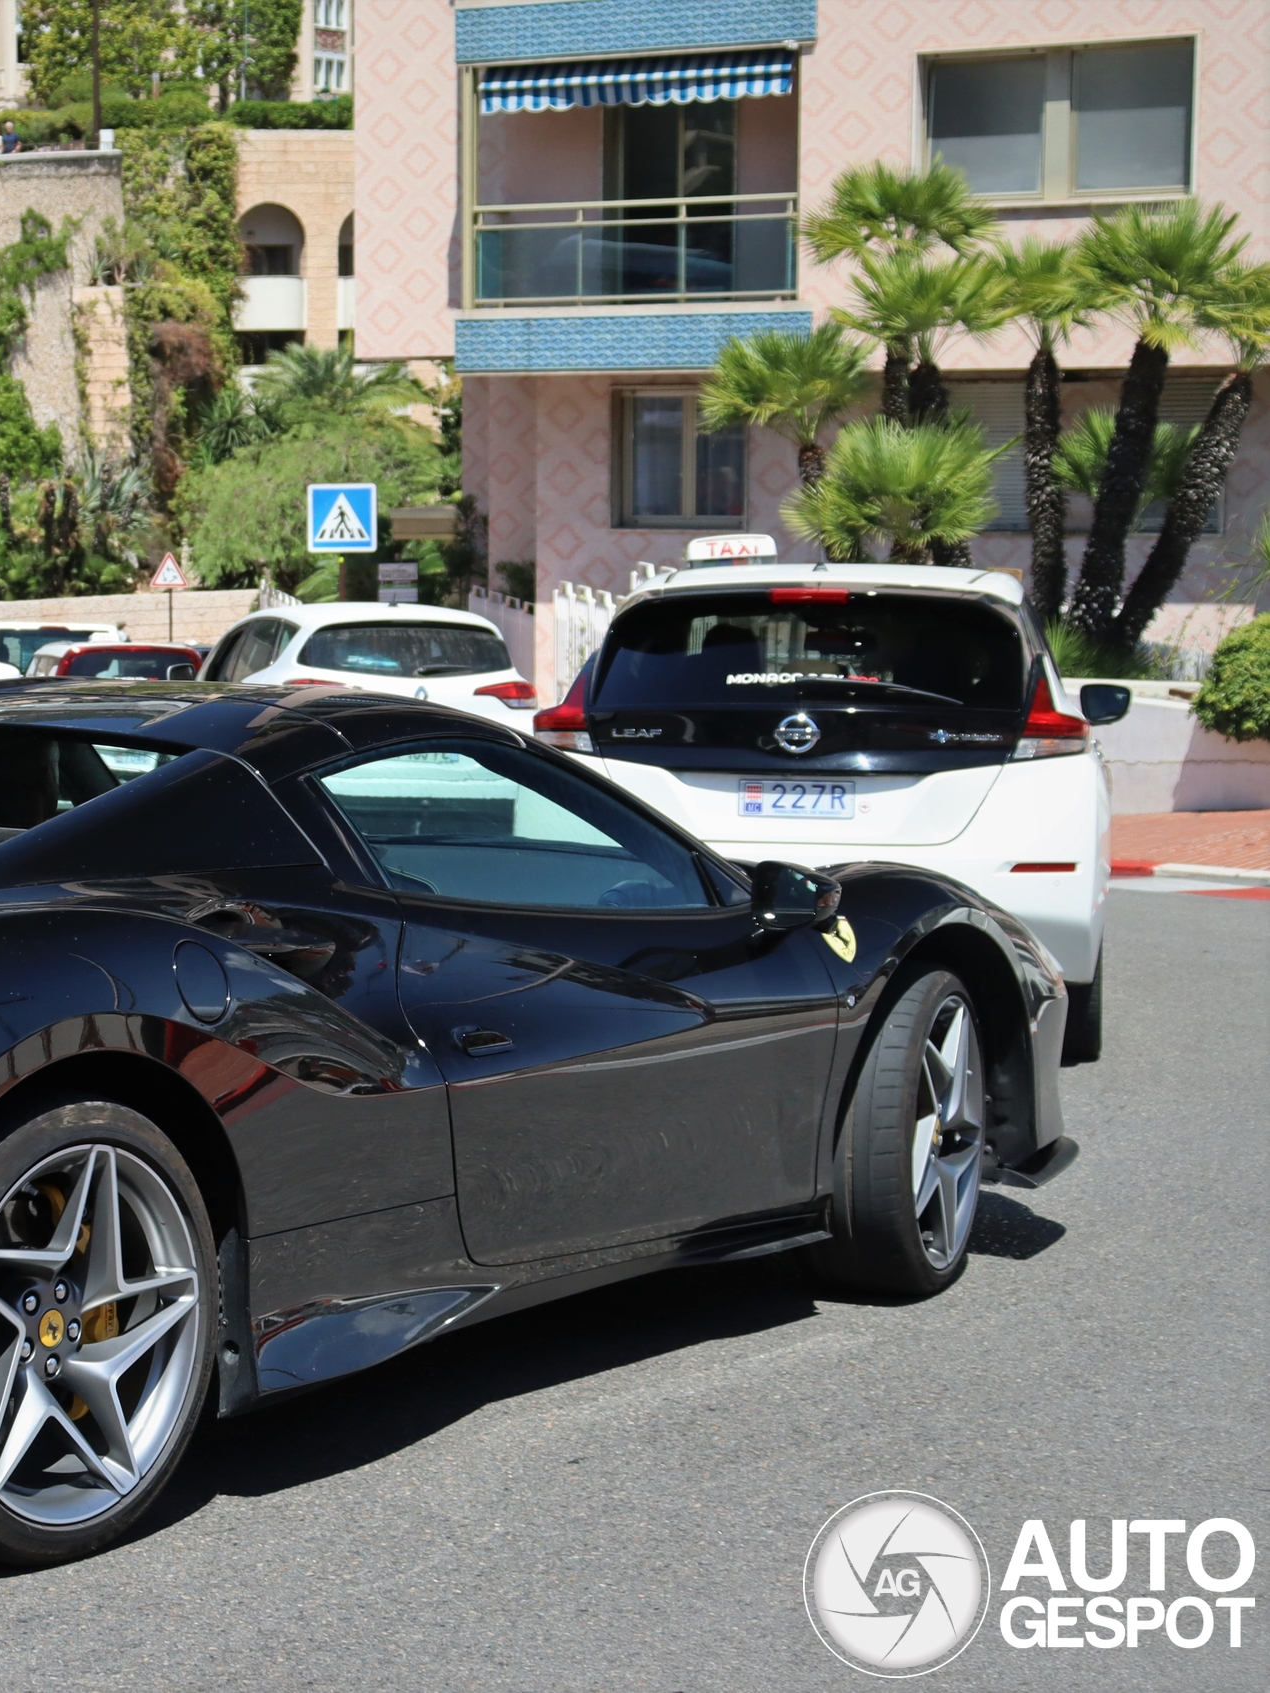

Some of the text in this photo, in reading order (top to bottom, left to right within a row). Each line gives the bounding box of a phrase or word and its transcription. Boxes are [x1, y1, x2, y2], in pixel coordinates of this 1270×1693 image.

[706, 541, 760, 557] TAXI
[612, 728, 663, 738] LEAF
[772, 784, 846, 809] 227R
[747, 803, 760, 812] MC
